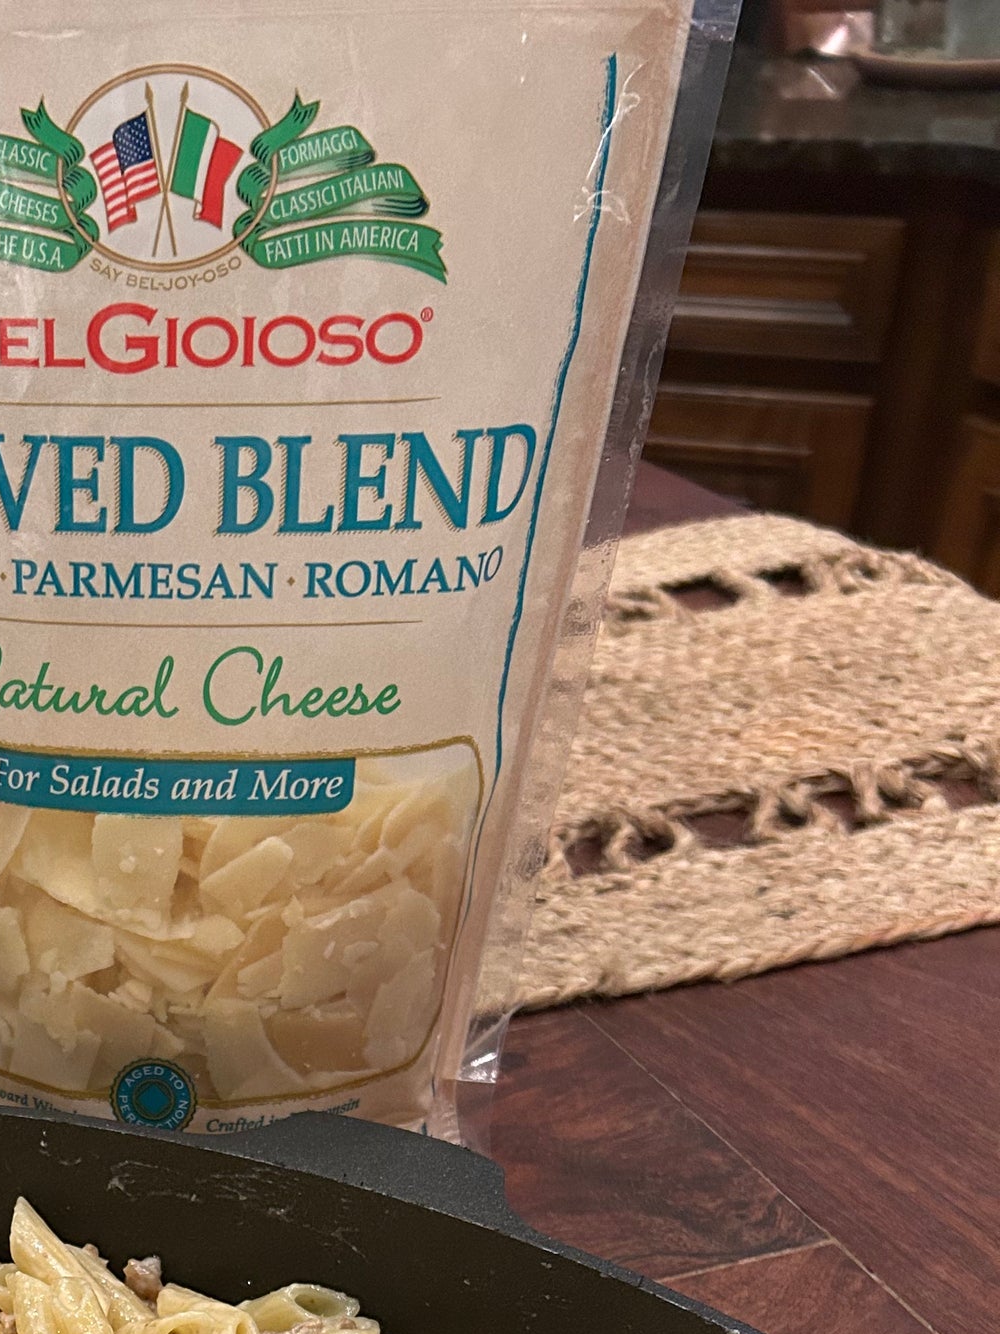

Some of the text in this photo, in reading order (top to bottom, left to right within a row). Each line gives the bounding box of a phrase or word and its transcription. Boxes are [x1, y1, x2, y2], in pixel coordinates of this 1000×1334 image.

[279, 130, 358, 169] FORMAGGI
[0, 190, 59, 224] CHEESES
[270, 170, 404, 220] CLASSICI ITALIANI
[22, 239, 65, 269] U.S.A.
[265, 226, 419, 263] FATTI IN AMERICA
[90, 256, 242, 291] SAY BEL-JOY-OSO
[213, 422, 537, 537] BLEND
[12, 559, 278, 600] PARMESAN
[303, 545, 504, 598] ROMANO
[202, 645, 402, 726] Cheese
[49, 764, 159, 800] Salads
[170, 769, 238, 800] and
[247, 769, 344, 800] More
[125, 1066, 184, 1090] AGED TO
[206, 1115, 265, 1132] Crafted
